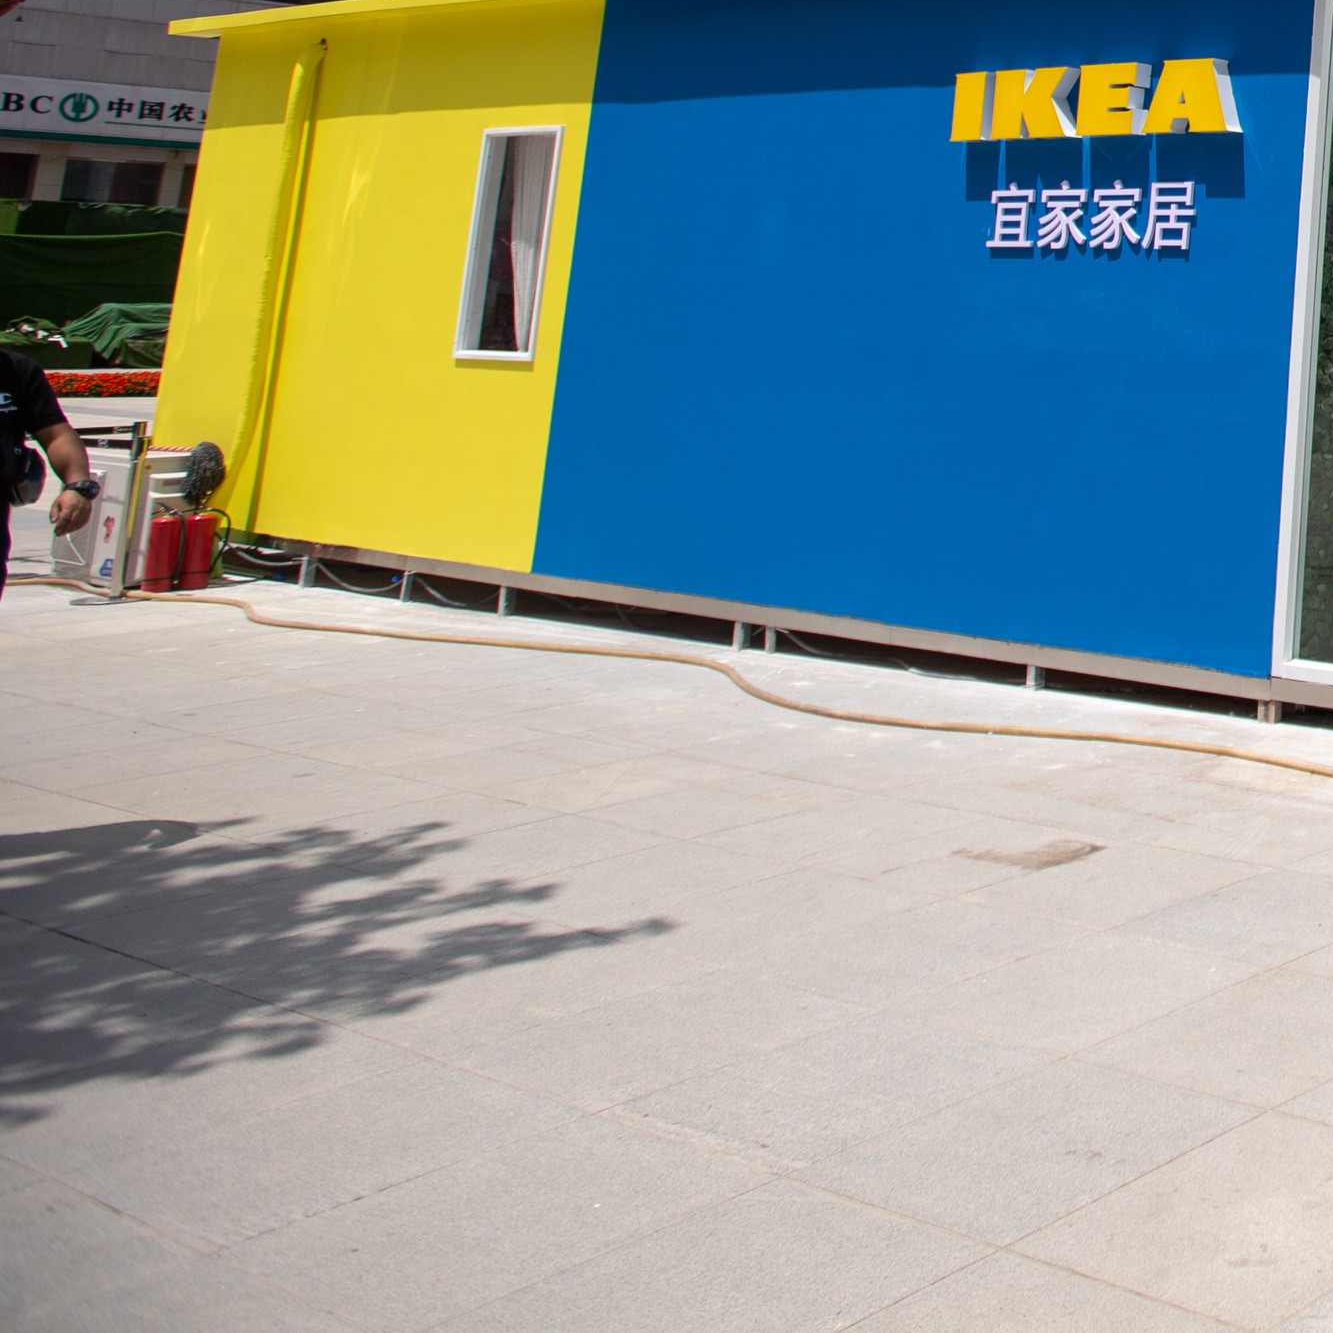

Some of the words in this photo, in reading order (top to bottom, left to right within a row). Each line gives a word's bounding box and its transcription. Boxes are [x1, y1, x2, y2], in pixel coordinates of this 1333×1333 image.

[950, 58, 1243, 142] IKEA
[986, 179, 1197, 251] 宜家家居
